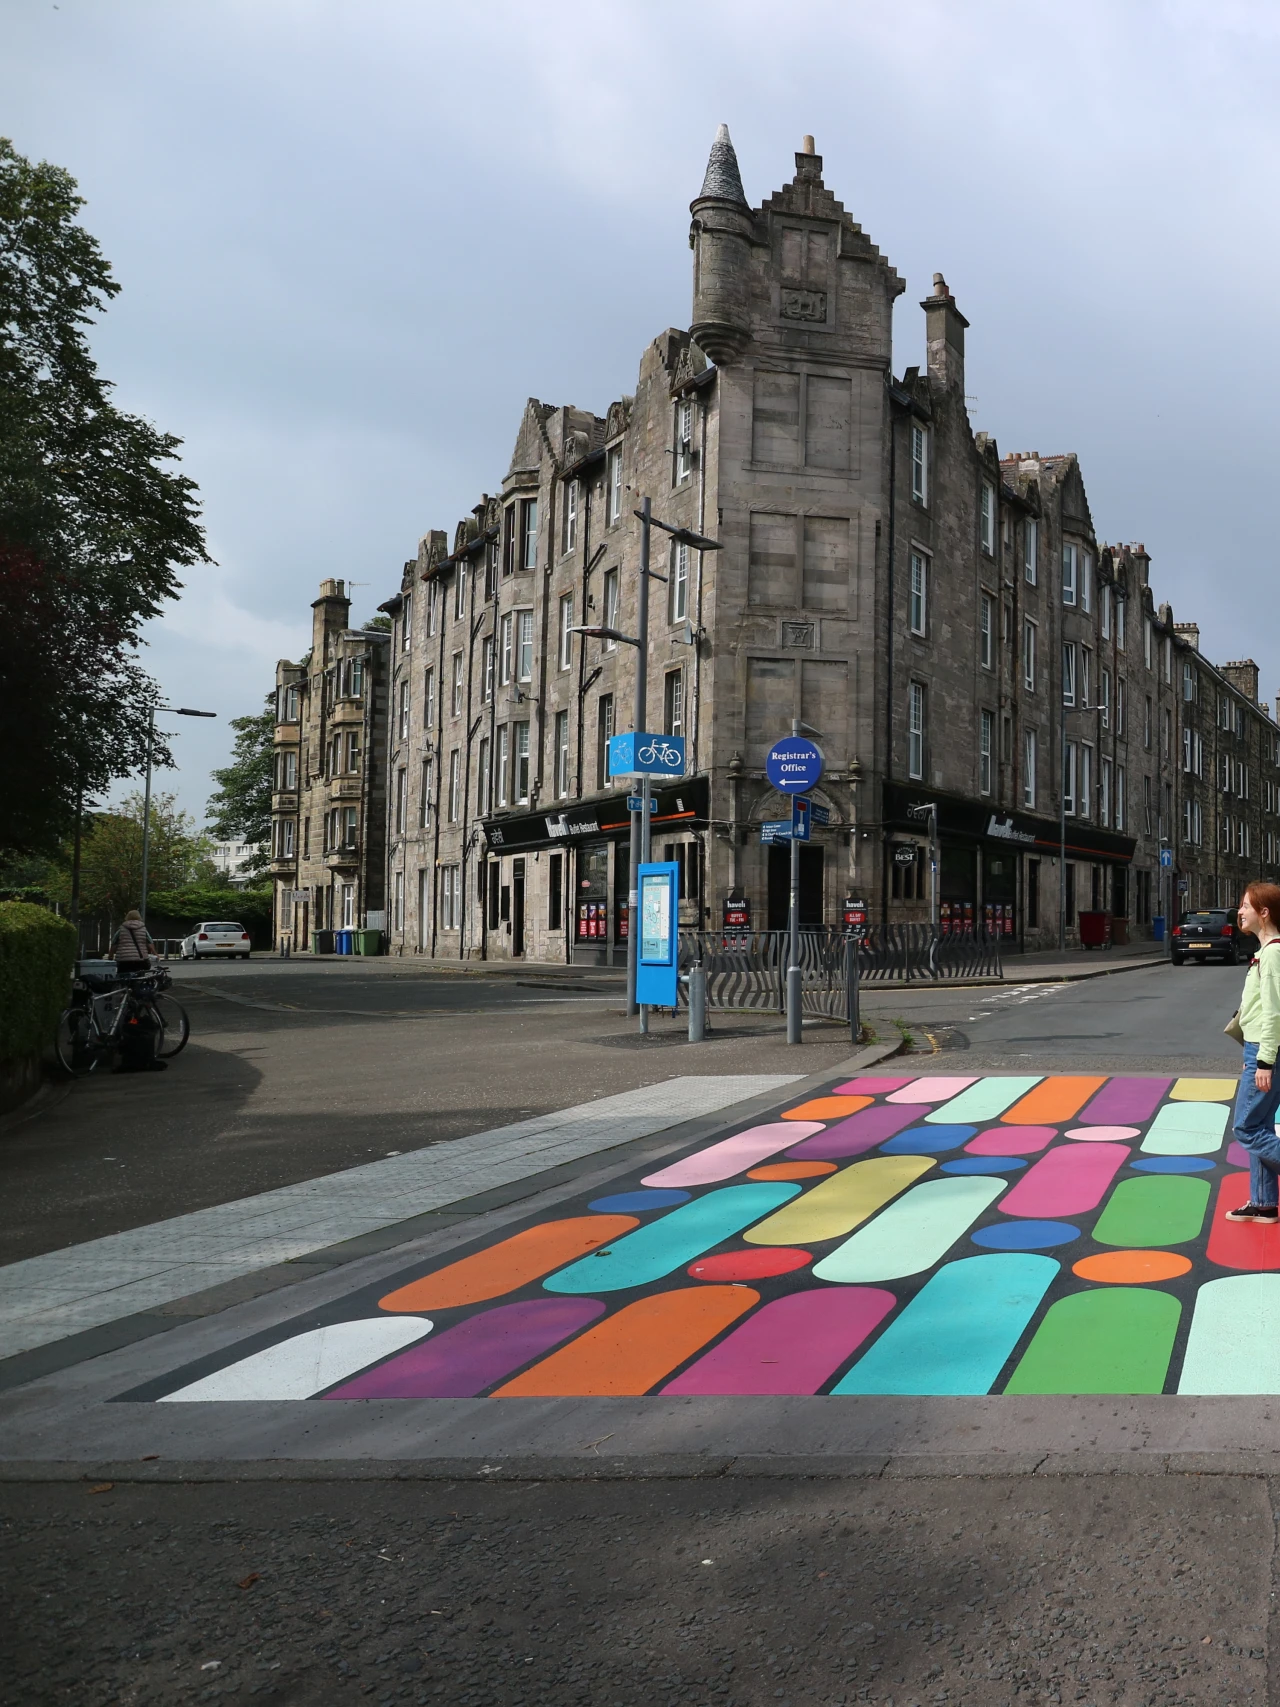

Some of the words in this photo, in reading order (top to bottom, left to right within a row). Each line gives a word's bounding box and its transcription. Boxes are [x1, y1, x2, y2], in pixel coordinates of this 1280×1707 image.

[772, 751, 816, 761] Registrar's
[781, 764, 806, 772] Office
[895, 853, 915, 861] BEST
[727, 900, 746, 908] haveli
[846, 900, 864, 908] haveli
